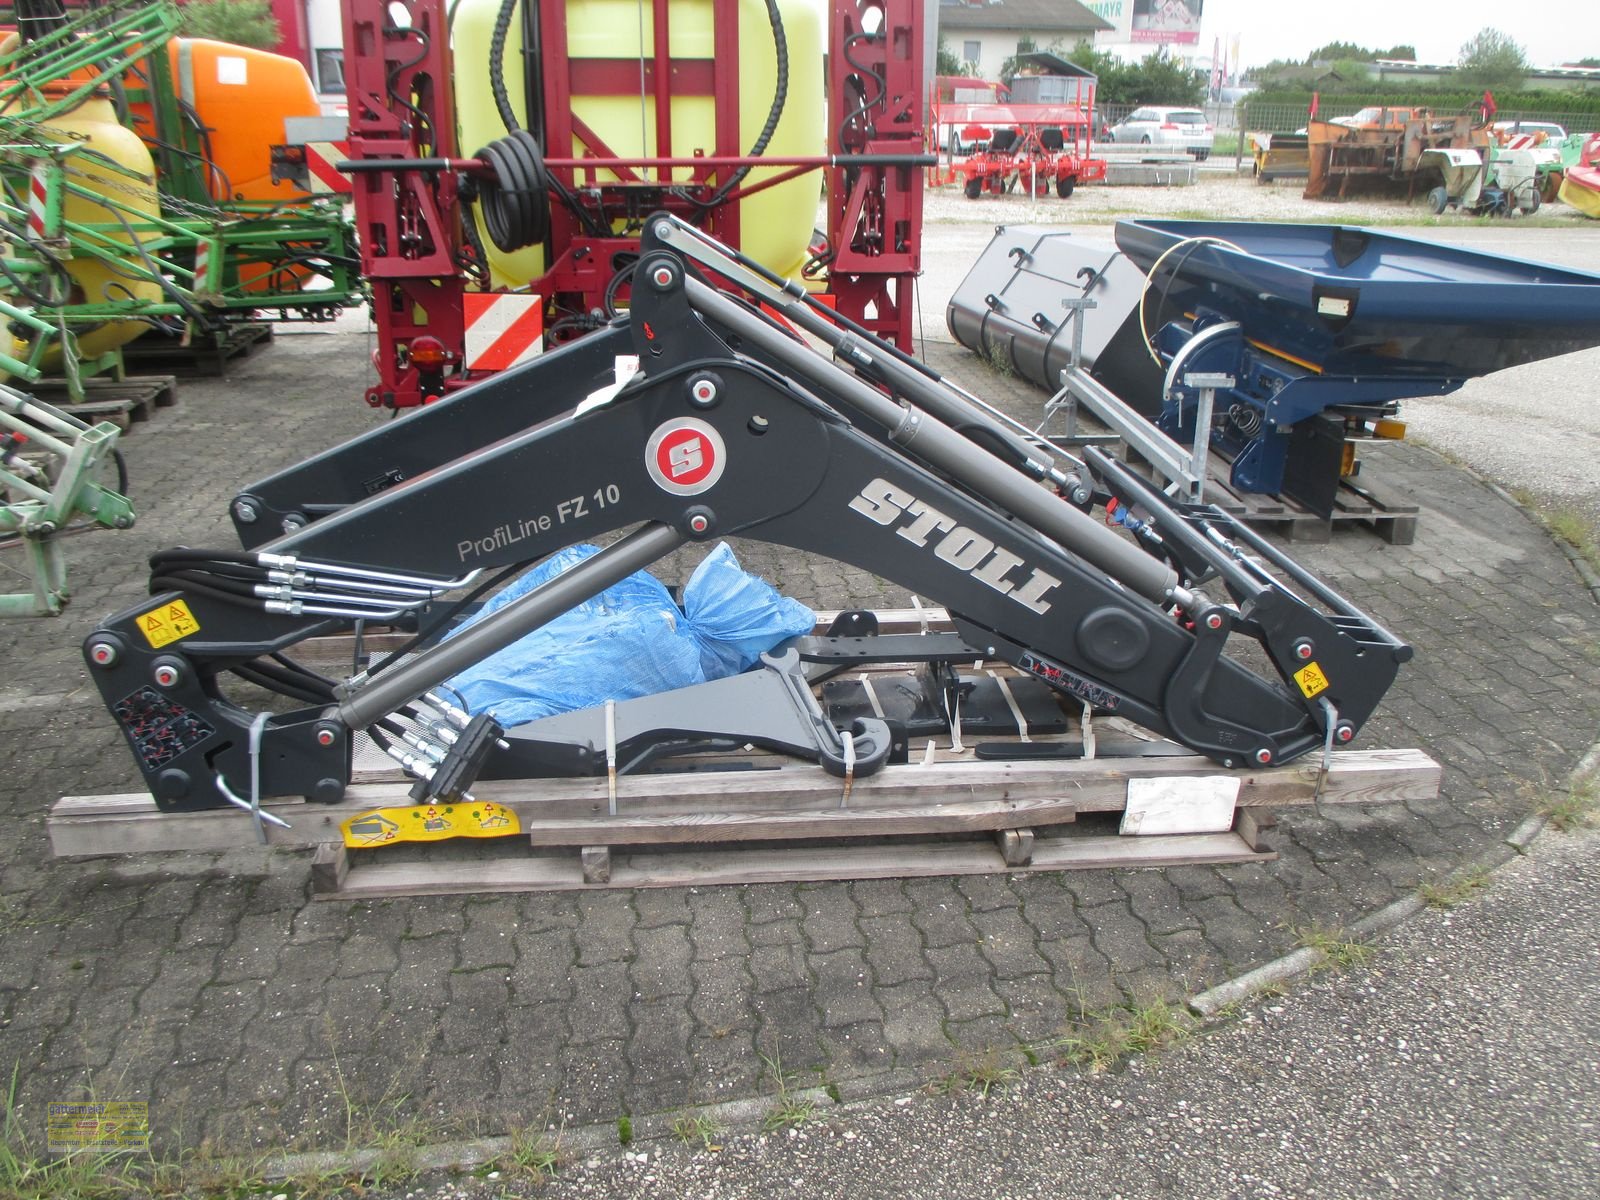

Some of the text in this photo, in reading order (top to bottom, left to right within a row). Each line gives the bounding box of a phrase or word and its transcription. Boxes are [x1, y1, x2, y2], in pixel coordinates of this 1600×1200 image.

[669, 437, 703, 477] S
[457, 484, 620, 562] ProfiLine FZ 10
[848, 478, 1062, 615] STOLL
